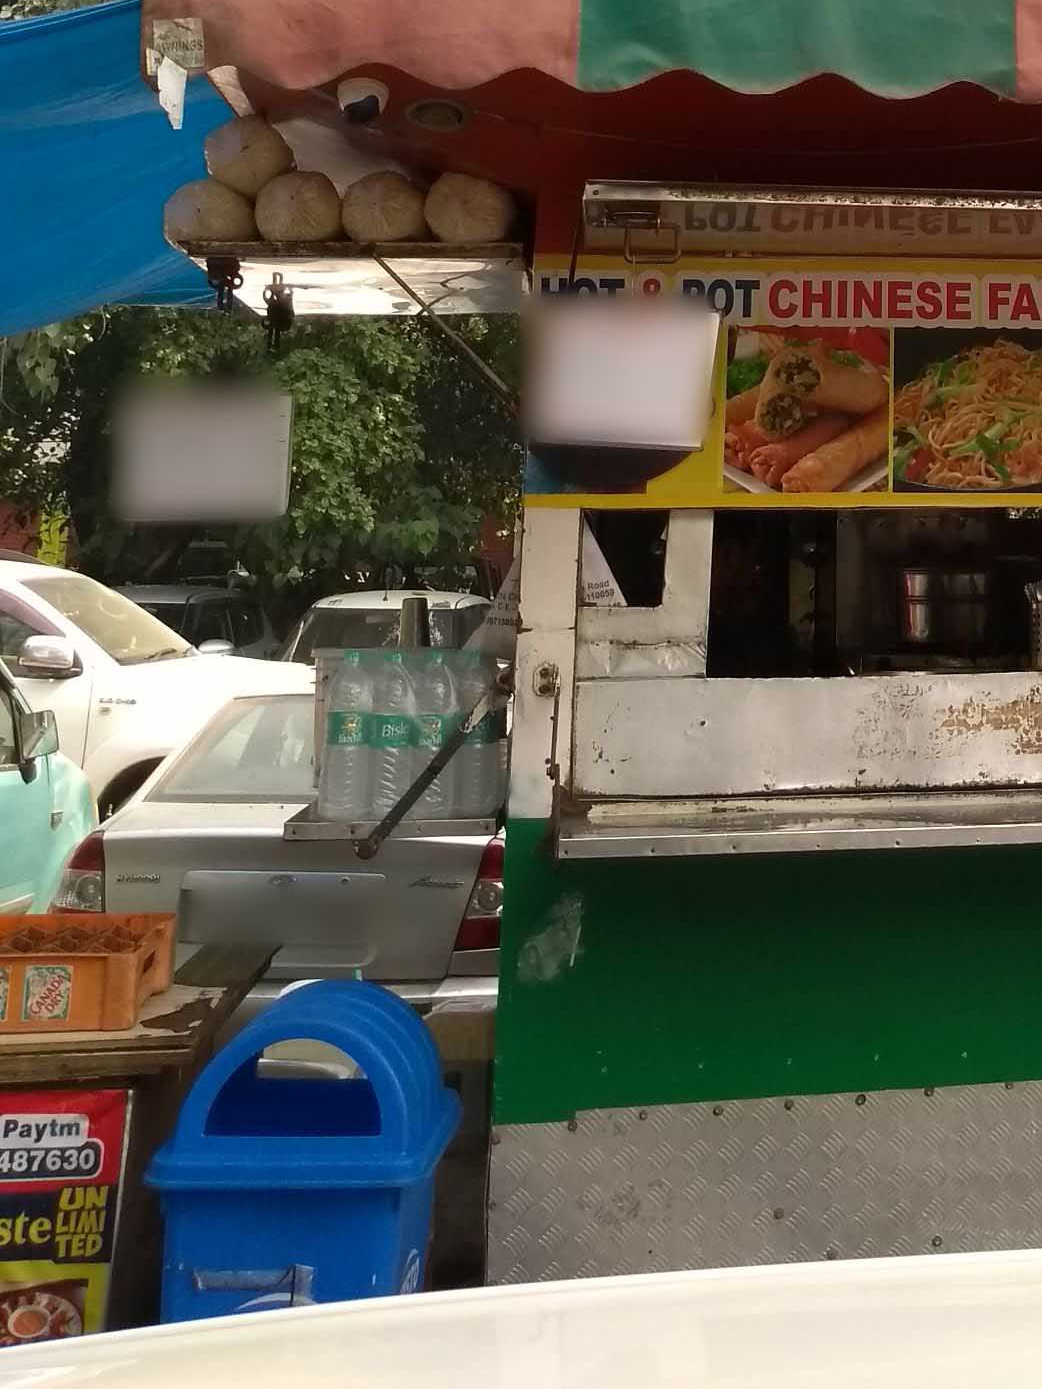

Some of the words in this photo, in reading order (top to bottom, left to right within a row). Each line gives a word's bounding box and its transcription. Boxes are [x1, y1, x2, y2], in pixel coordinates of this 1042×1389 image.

[768, 279, 972, 320] CHINESE
[30, 974, 70, 1014] CANADA
[3, 1119, 80, 1143] Paytm
[0, 1148, 95, 1173] 487630
[59, 1186, 109, 1210] UN
[56, 1210, 107, 1234] LIMI
[56, 1234, 104, 1259] TED
